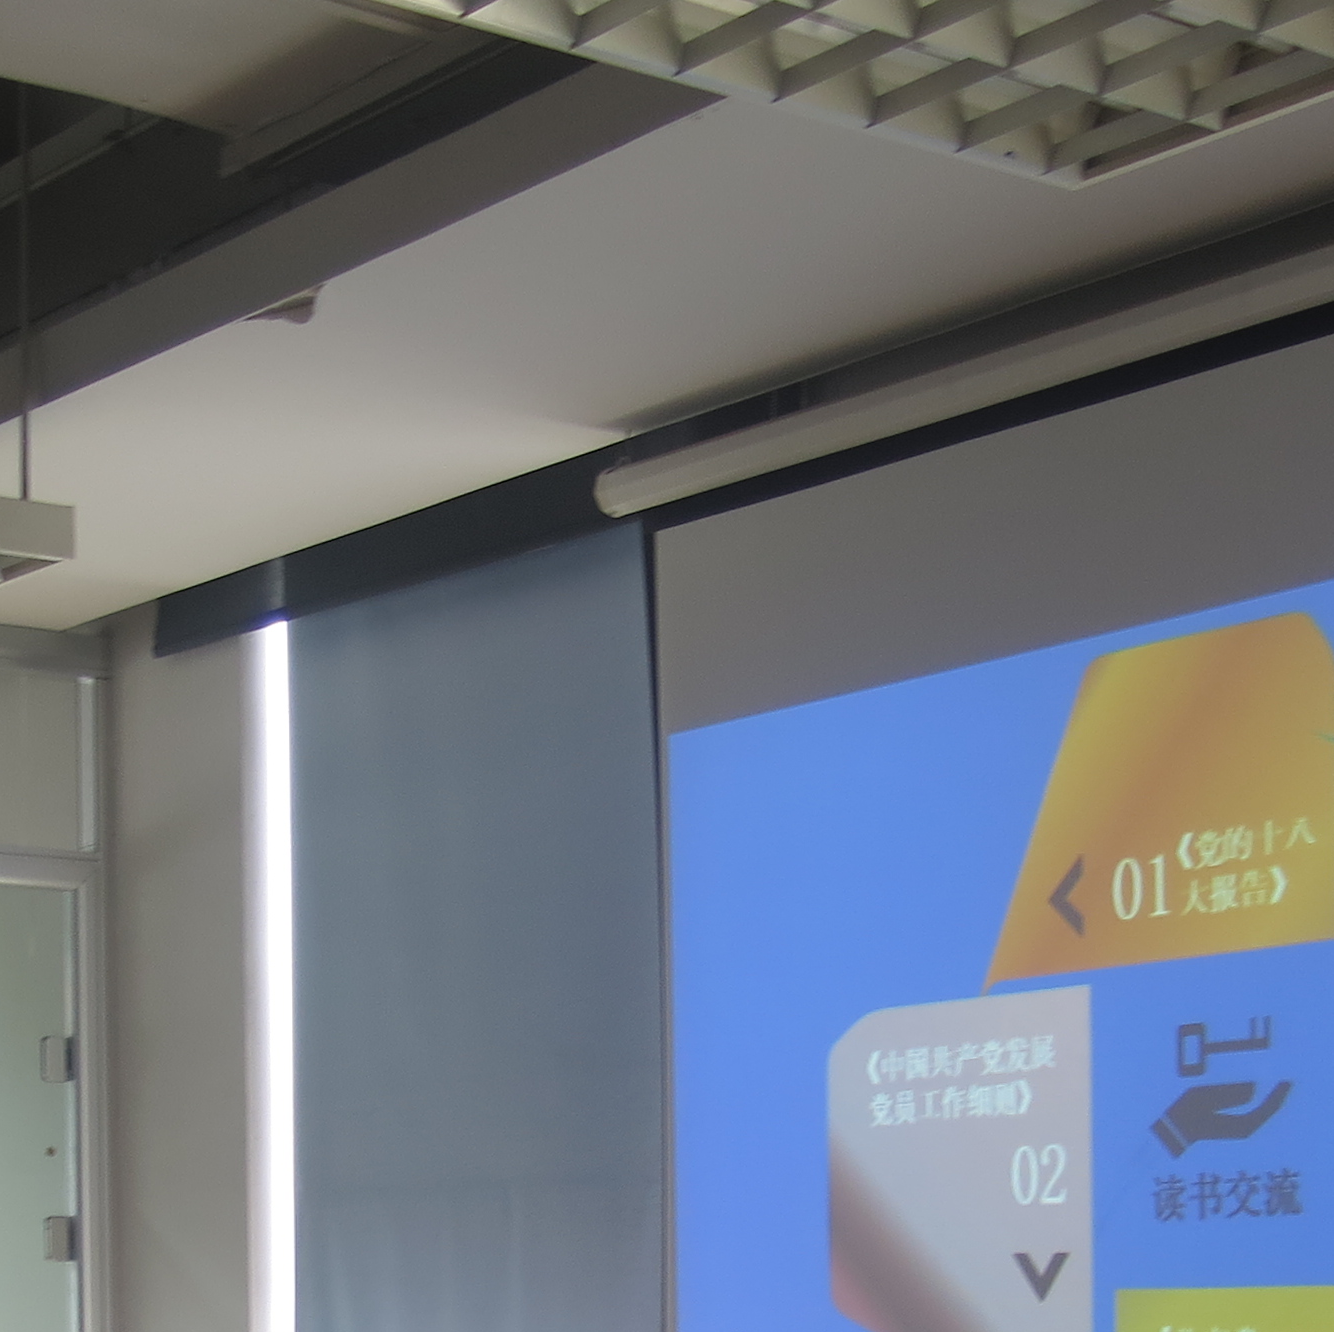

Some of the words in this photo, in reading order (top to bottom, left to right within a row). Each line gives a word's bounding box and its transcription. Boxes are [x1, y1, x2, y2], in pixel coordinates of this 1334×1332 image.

[1111, 855, 1170, 921] 01
[1010, 1143, 1068, 1205] 02
[1152, 1168, 1304, 1221] 读书交流
